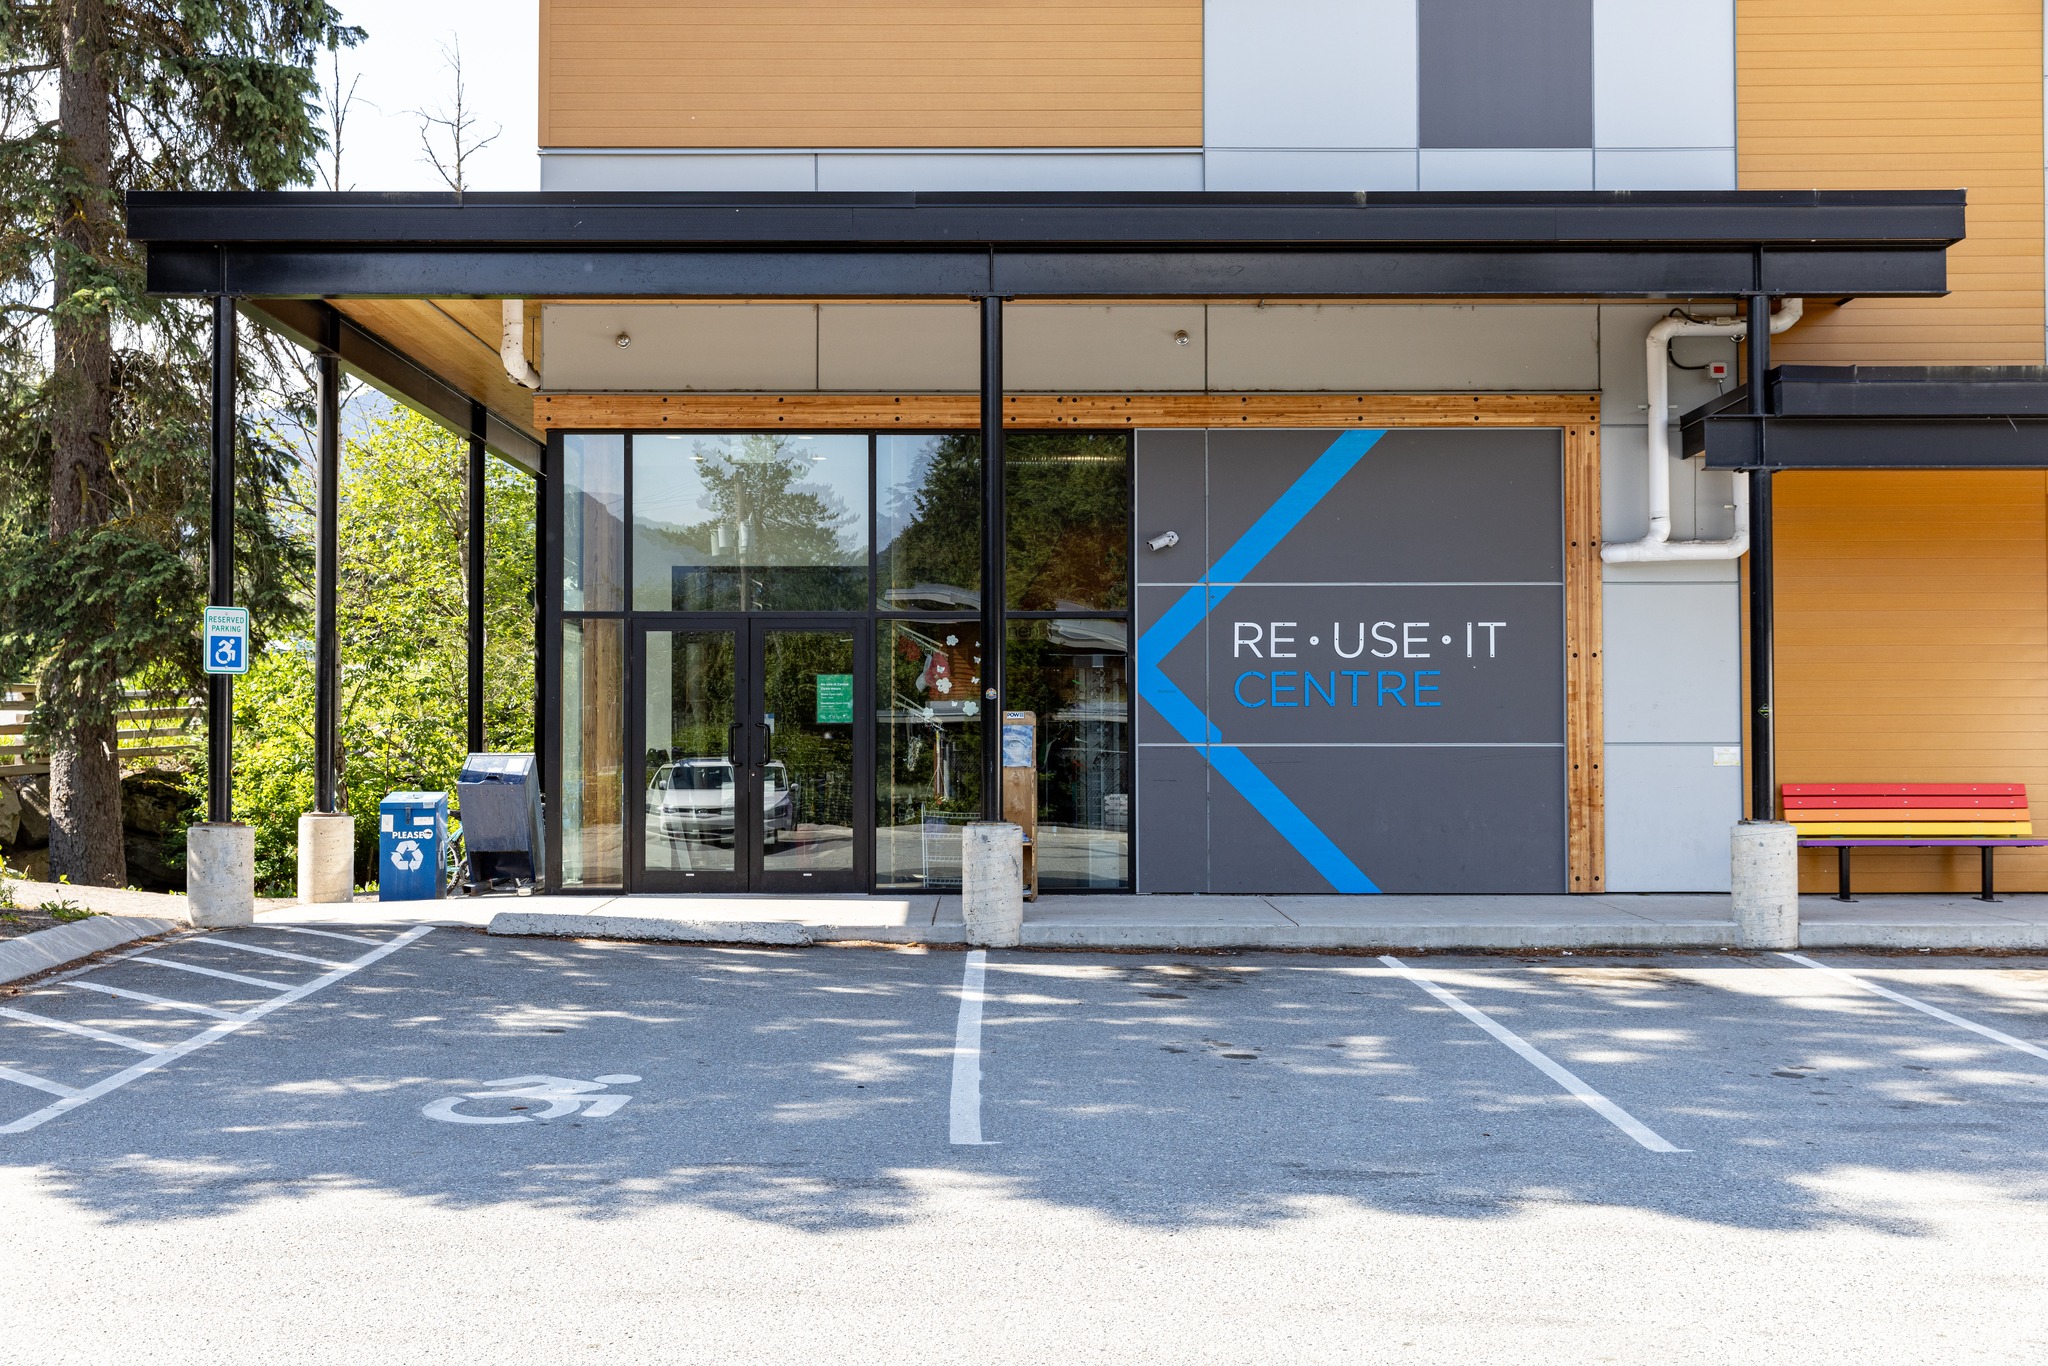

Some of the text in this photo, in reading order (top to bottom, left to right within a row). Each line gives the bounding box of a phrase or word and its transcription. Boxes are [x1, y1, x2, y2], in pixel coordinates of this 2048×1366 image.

[208, 616, 244, 624] RESERVED
[211, 625, 242, 633] PARKING
[1234, 670, 1441, 708] CENTRE
[392, 831, 424, 839] PLEASE
